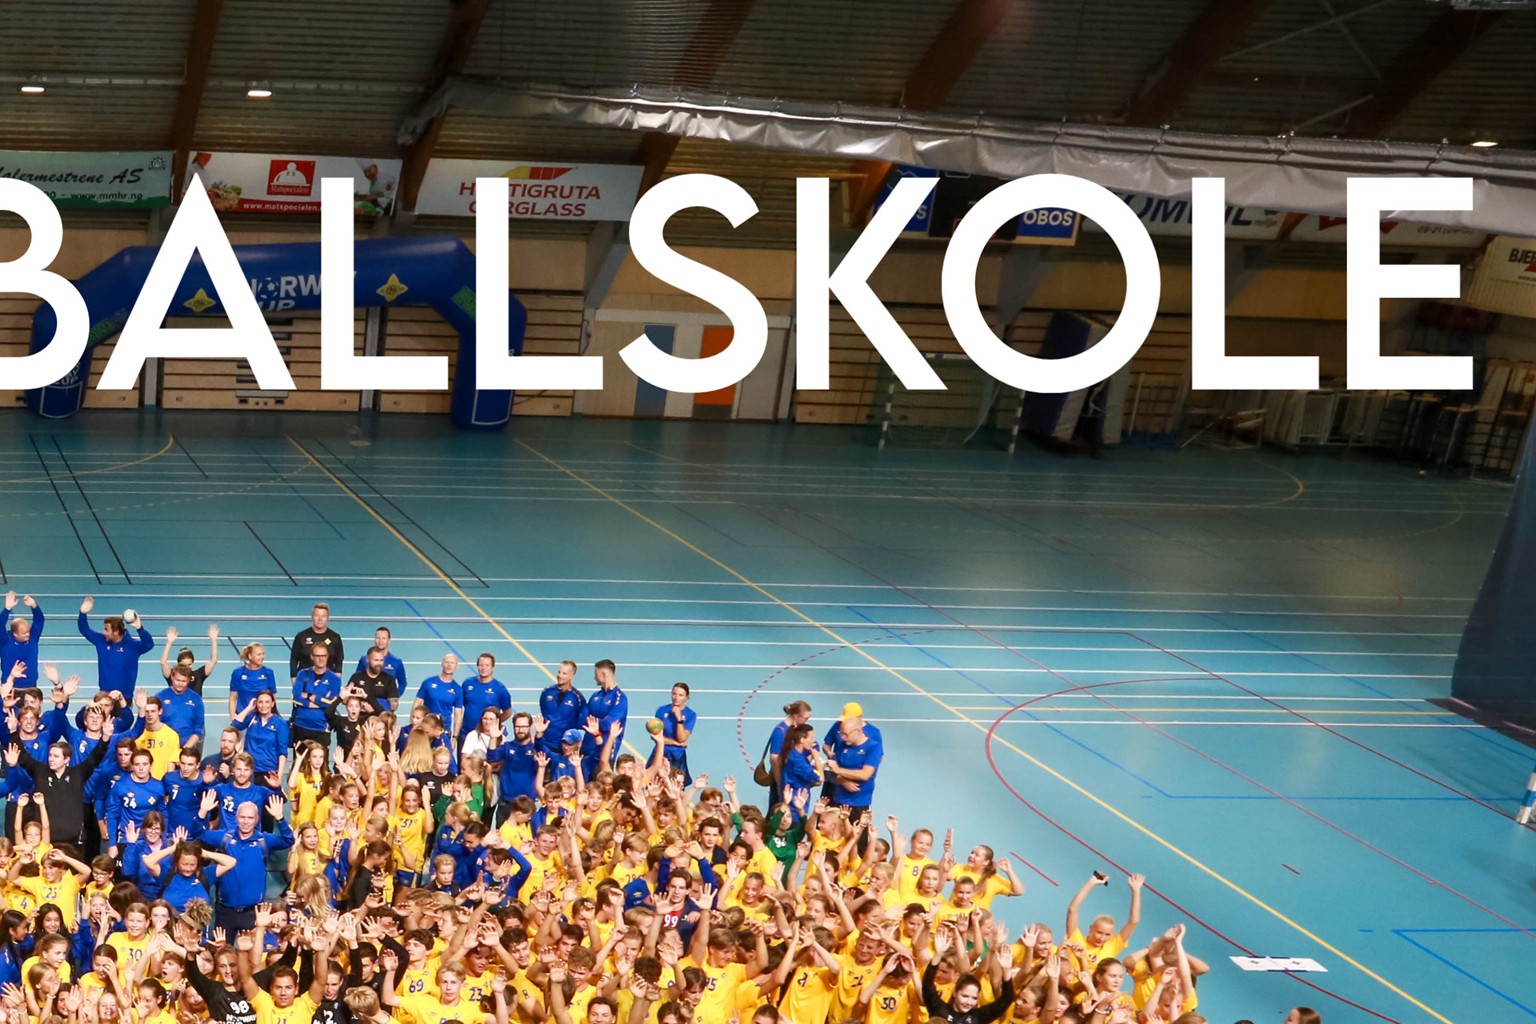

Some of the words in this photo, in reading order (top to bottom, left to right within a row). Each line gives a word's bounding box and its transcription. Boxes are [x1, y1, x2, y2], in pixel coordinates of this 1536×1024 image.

[110, 168, 144, 184] AS
[459, 182, 601, 199] HTIGRUTA
[244, 202, 321, 211] www.matspecialen.
[469, 201, 586, 217] CRGLASS
[1023, 209, 1073, 226] OBOS
[172, 788, 178, 800] 7
[124, 797, 137, 809] 24
[222, 800, 235, 812] 22
[409, 979, 424, 993] 69
[469, 987, 483, 1001] 23
[230, 1001, 249, 1015] 98
[881, 995, 897, 1011] 30
